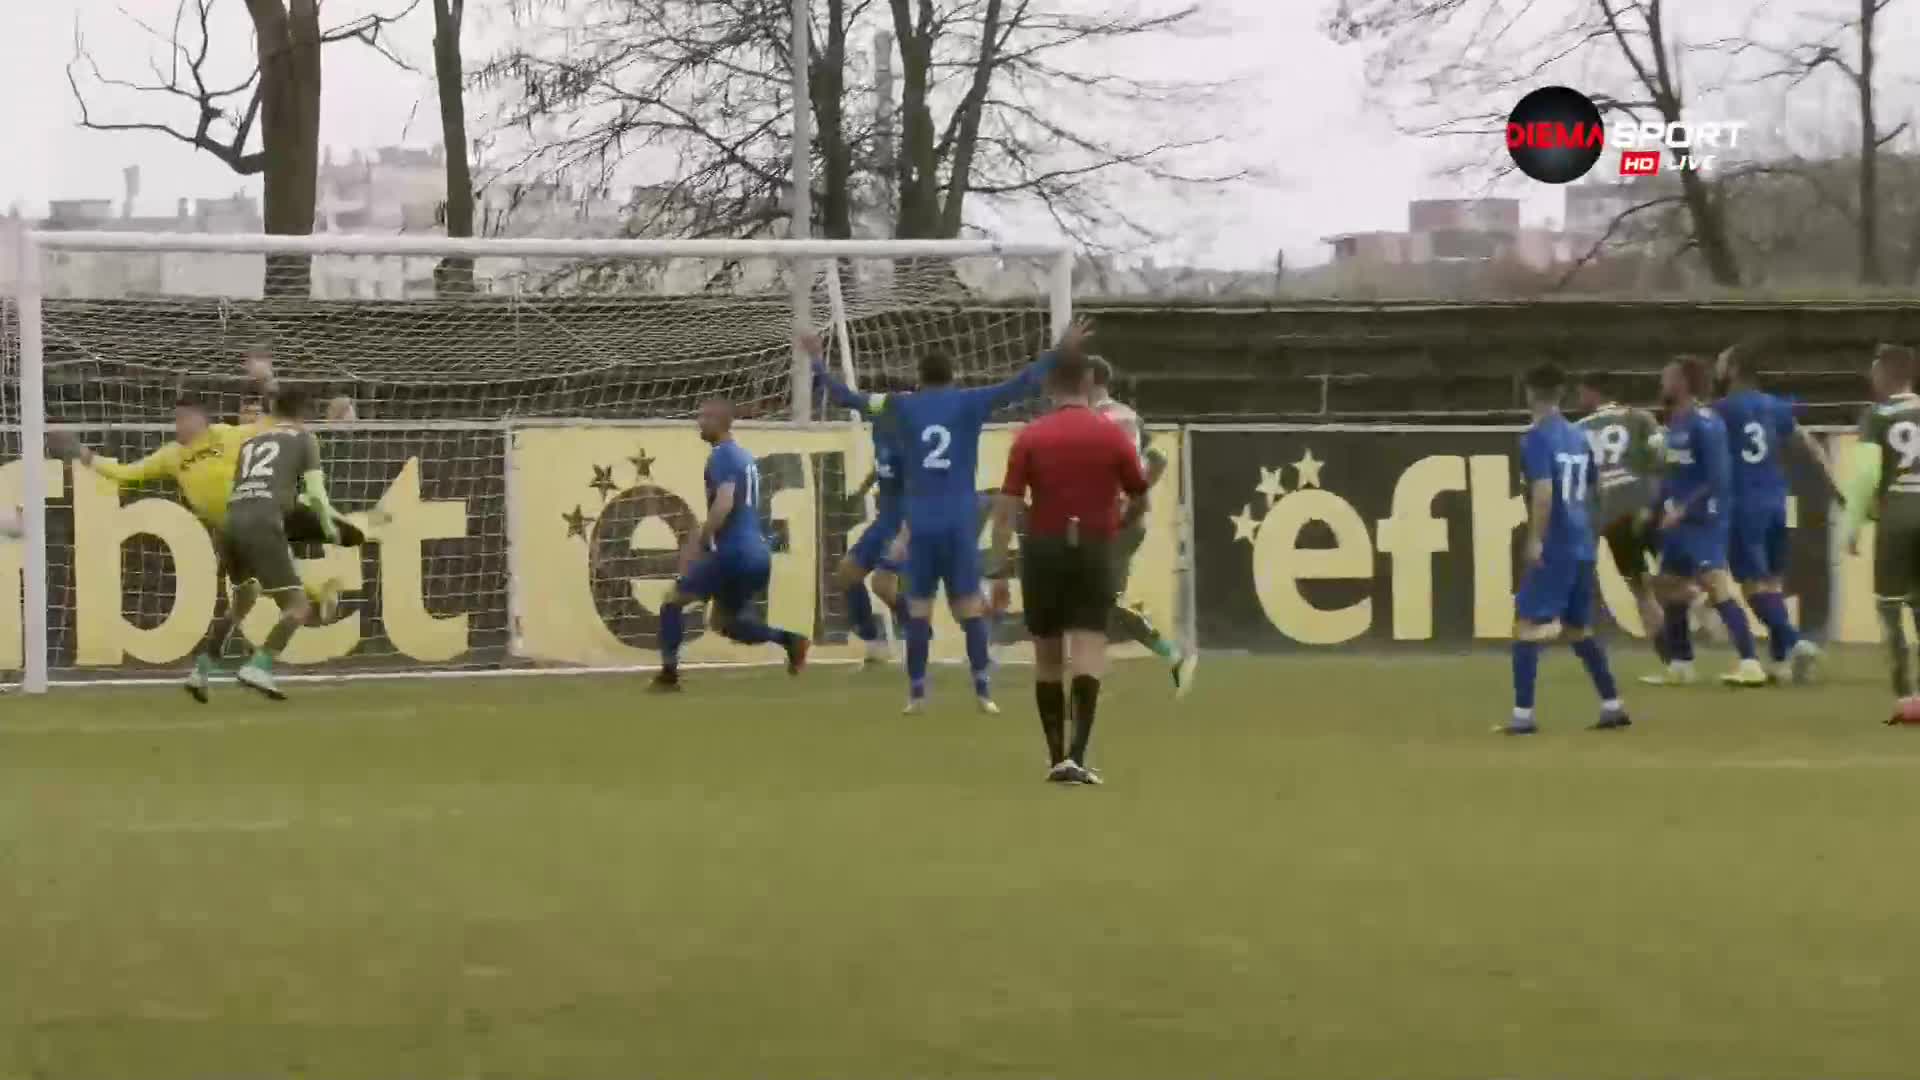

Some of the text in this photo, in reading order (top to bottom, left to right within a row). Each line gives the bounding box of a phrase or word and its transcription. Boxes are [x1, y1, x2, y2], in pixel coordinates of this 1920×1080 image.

[242, 441, 280, 479] 12
[921, 424, 952, 470] 2
[1741, 421, 1768, 464] 3
